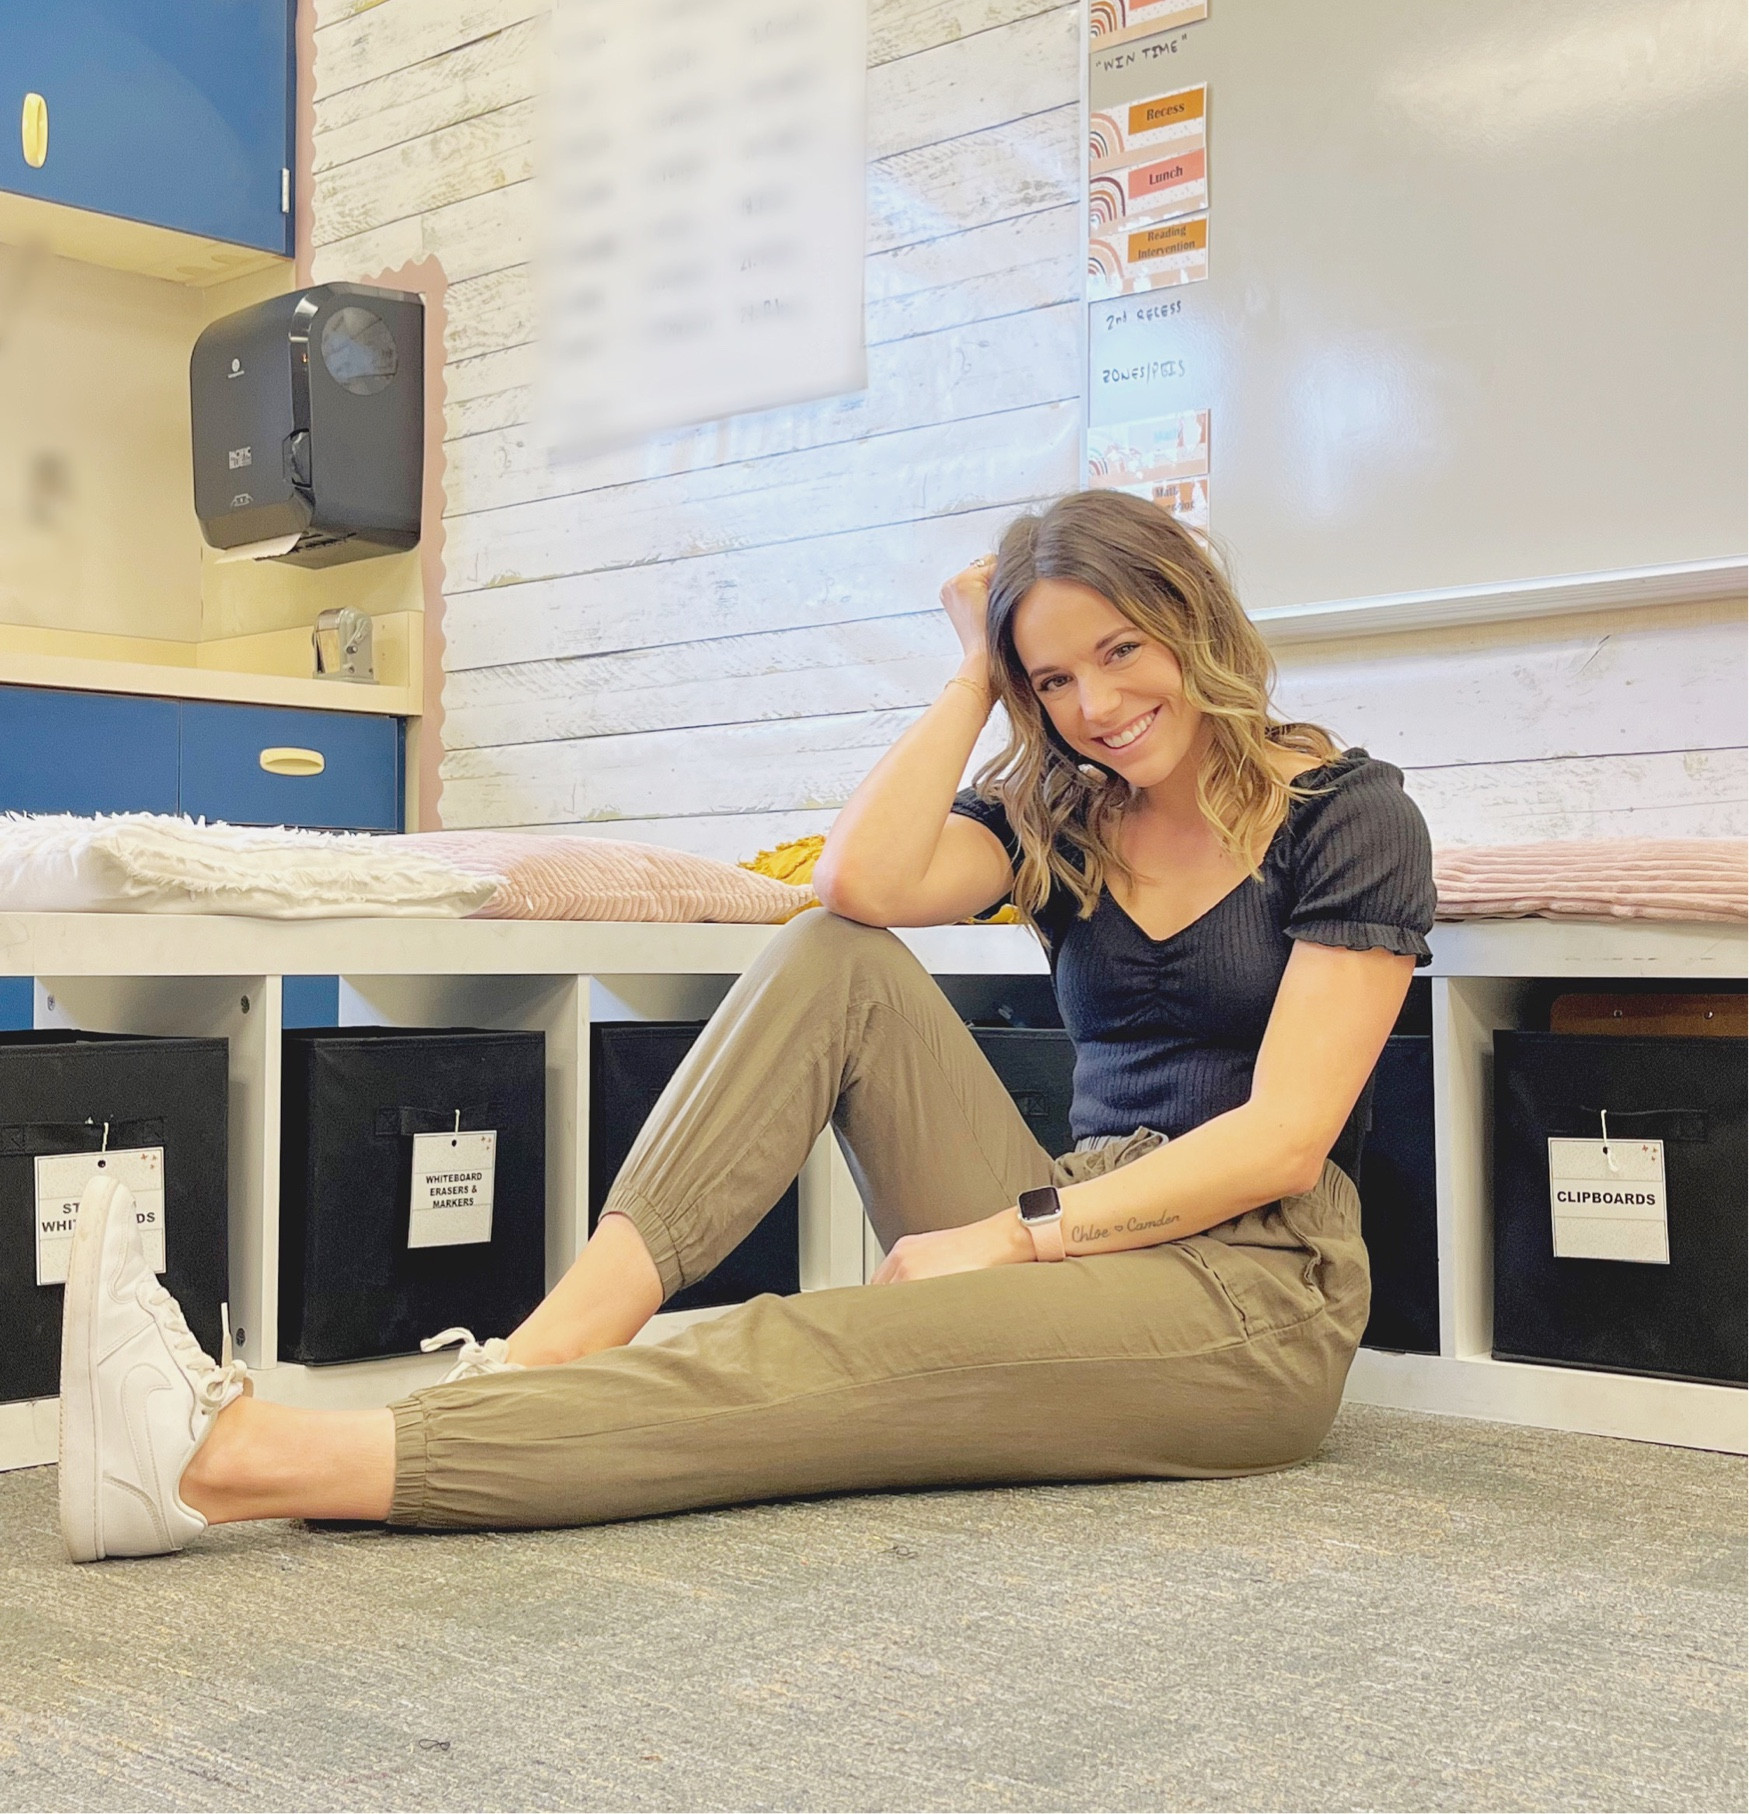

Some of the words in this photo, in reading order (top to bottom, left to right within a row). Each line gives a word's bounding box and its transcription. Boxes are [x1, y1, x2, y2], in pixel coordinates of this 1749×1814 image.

[1146, 103, 1185, 121] Recess
[1148, 165, 1183, 185] Lunch
[1147, 225, 1187, 242] Reading
[1137, 239, 1196, 259] Intervention
[426, 1172, 482, 1184] WHITEBOARD
[430, 1186, 468, 1196] ERASERS
[471, 1185, 478, 1194] &
[1557, 1191, 1656, 1205] CLIPBOARDS
[433, 1198, 474, 1209] MARKERS
[1071, 1224, 1110, 1243] Chloe
[1127, 1209, 1180, 1232] Camden
